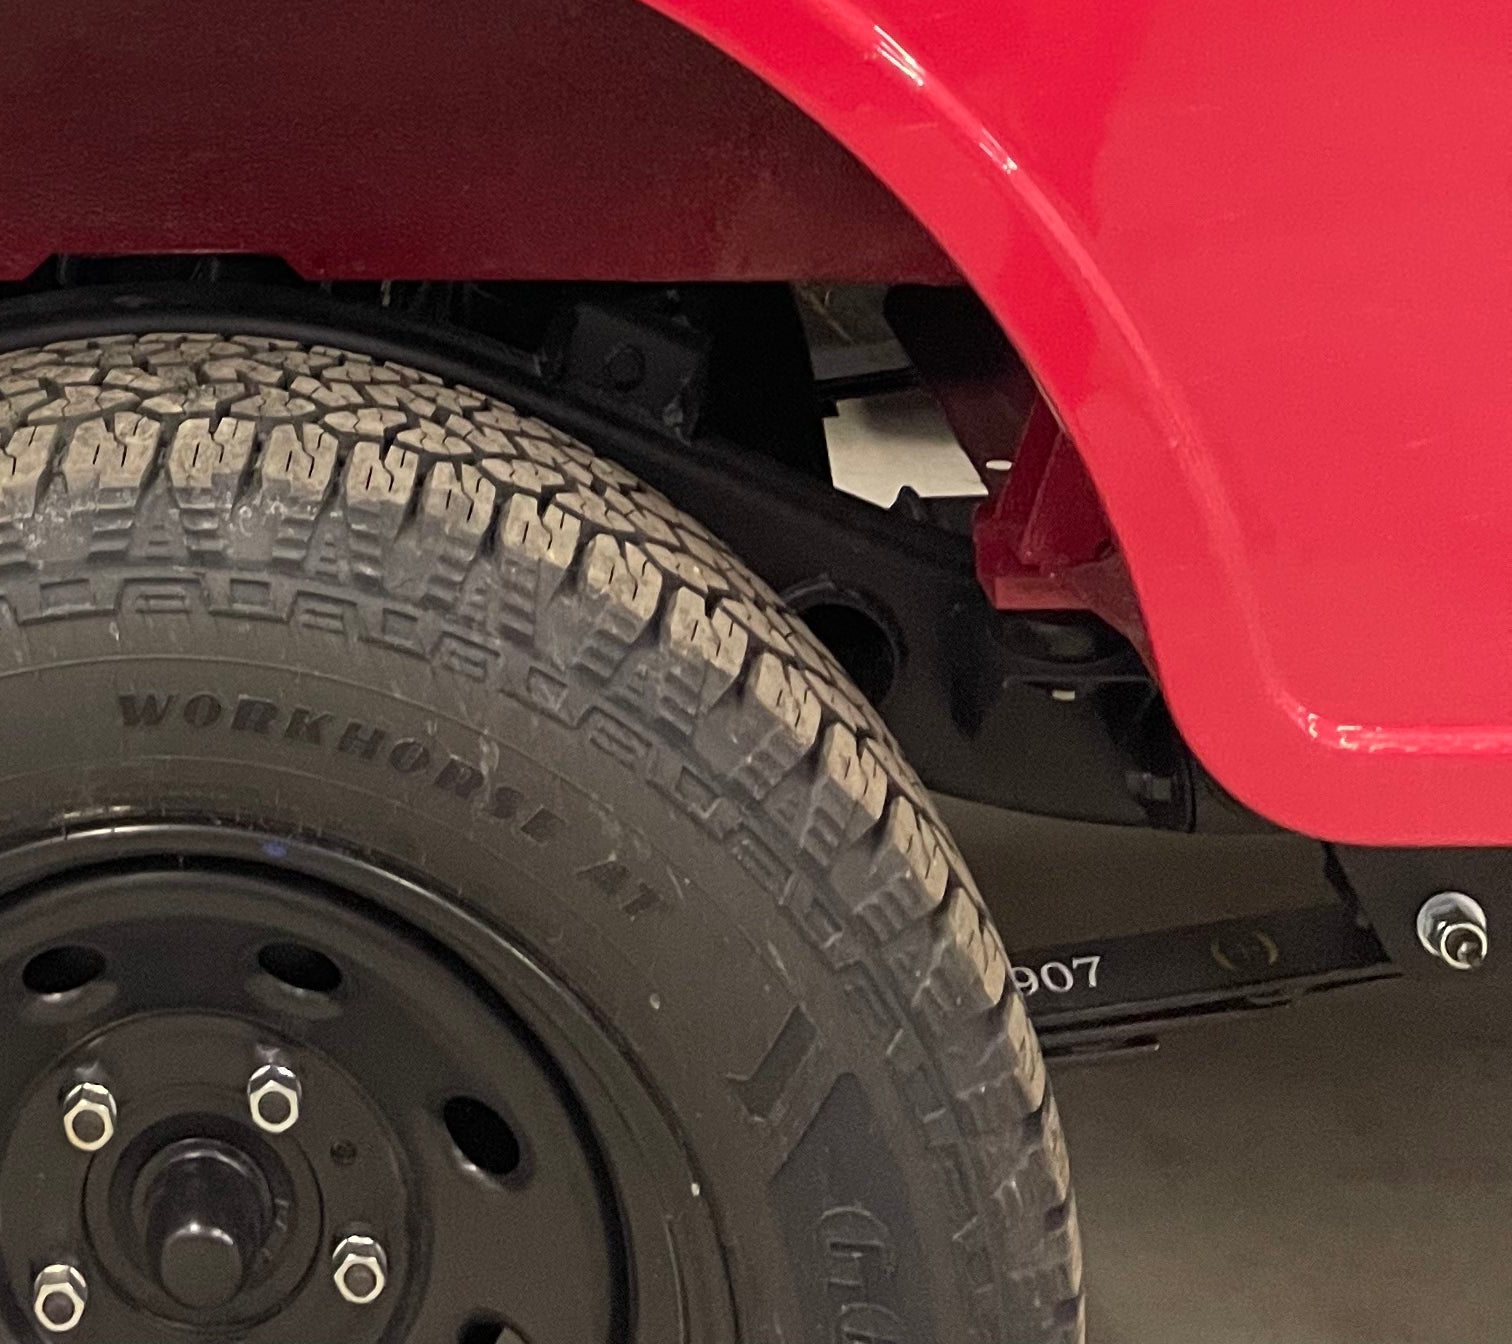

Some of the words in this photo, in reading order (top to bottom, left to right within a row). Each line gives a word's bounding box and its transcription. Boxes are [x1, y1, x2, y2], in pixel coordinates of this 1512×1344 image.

[117, 692, 566, 846] WORKHORSE
[575, 857, 666, 917] AT
[1010, 955, 1101, 996] 907
